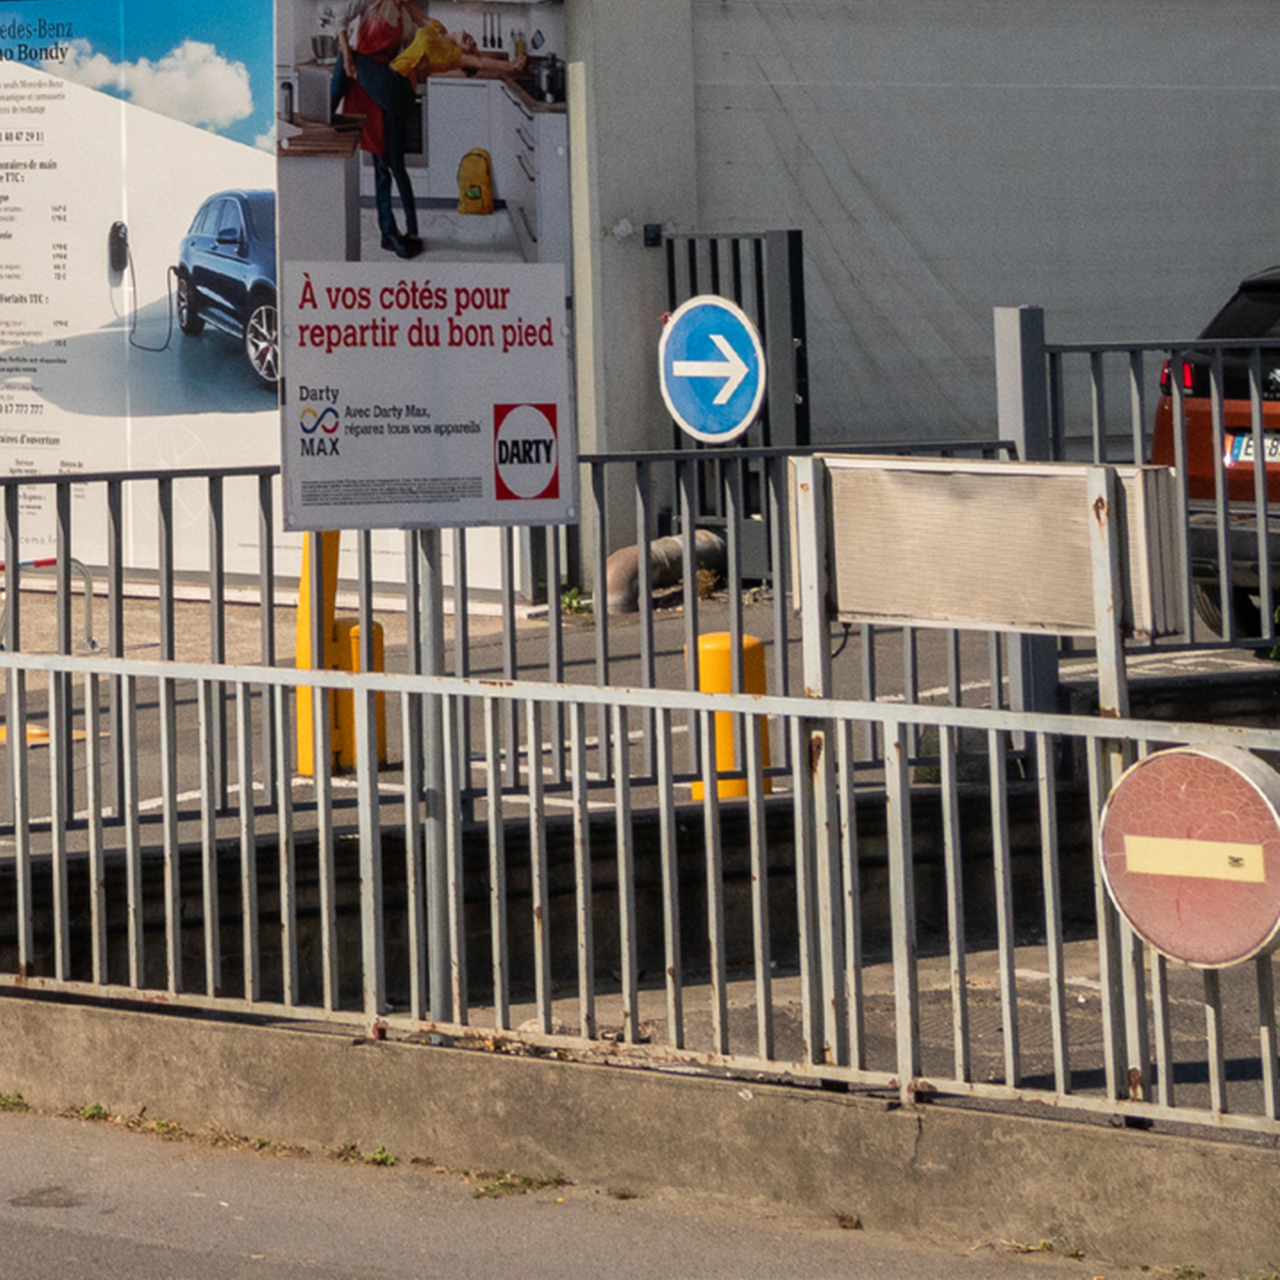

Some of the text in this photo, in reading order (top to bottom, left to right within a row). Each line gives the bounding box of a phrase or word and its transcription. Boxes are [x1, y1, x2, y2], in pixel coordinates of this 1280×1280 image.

[17, 42, 69, 64] Bondy
[298, 272, 510, 317] À vos côtés pour
[298, 317, 554, 354] repartir du bon pied
[298, 386, 340, 404] Darty
[344, 404, 431, 421] Avec Darty Max,
[344, 422, 384, 437] réparez
[387, 422, 410, 434] tous
[413, 425, 432, 434] vos
[300, 438, 340, 457] MAX
[498, 438, 554, 465] DARTY
